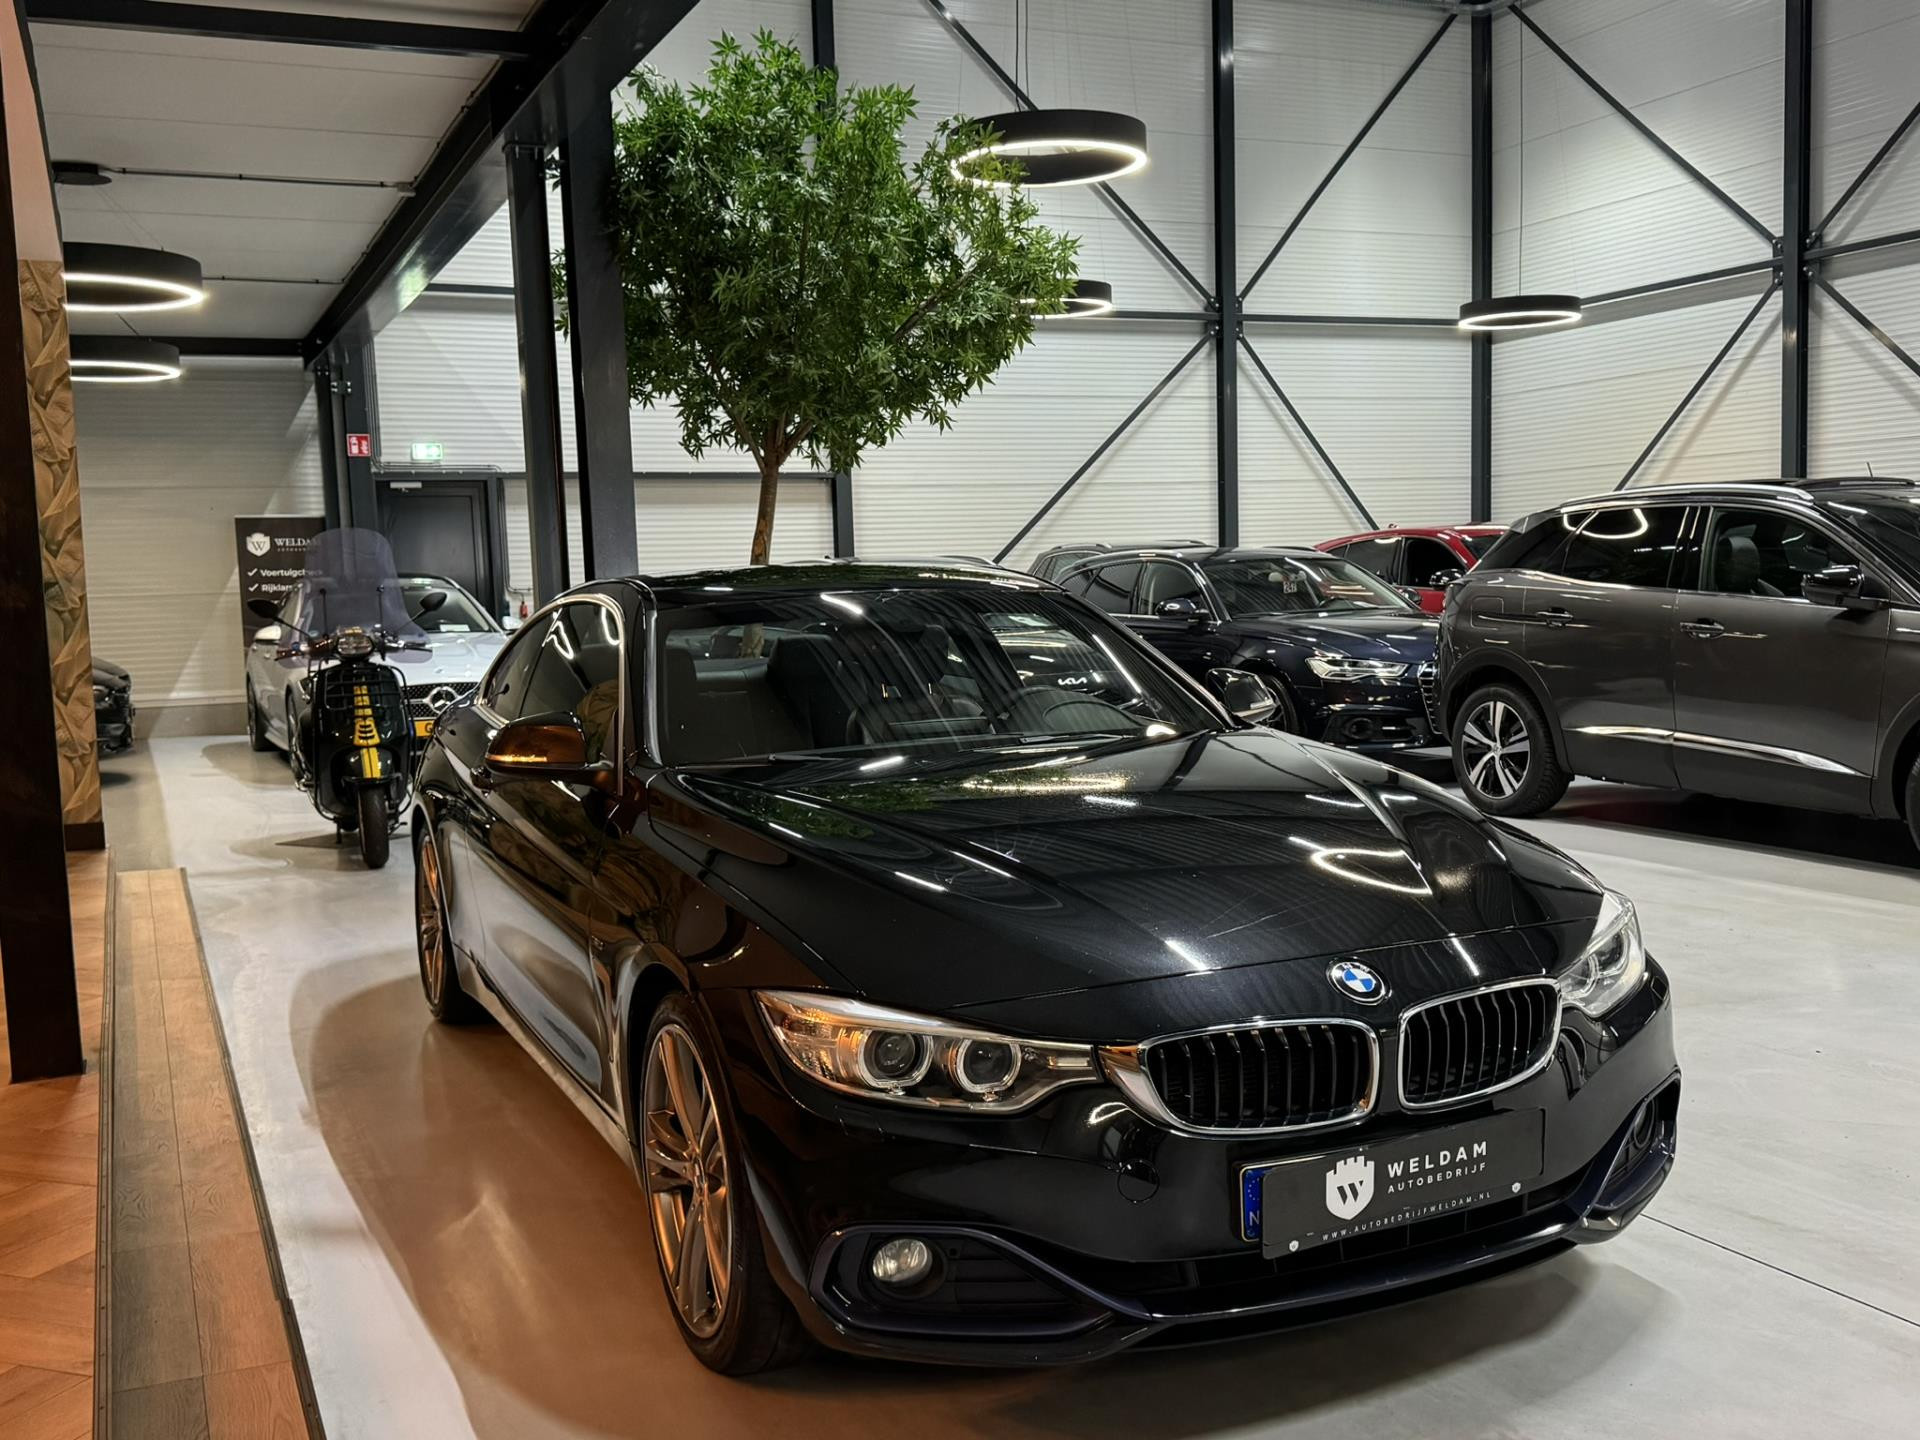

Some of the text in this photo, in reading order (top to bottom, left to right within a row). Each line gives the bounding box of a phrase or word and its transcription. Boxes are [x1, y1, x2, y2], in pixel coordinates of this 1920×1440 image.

[1387, 1141, 1487, 1178] WELDAM
[1387, 1162, 1486, 1194] AUTOBEDRIJF
[1322, 1192, 1491, 1241] WWW.AUTOBEDRIJFWELDAM.NL
